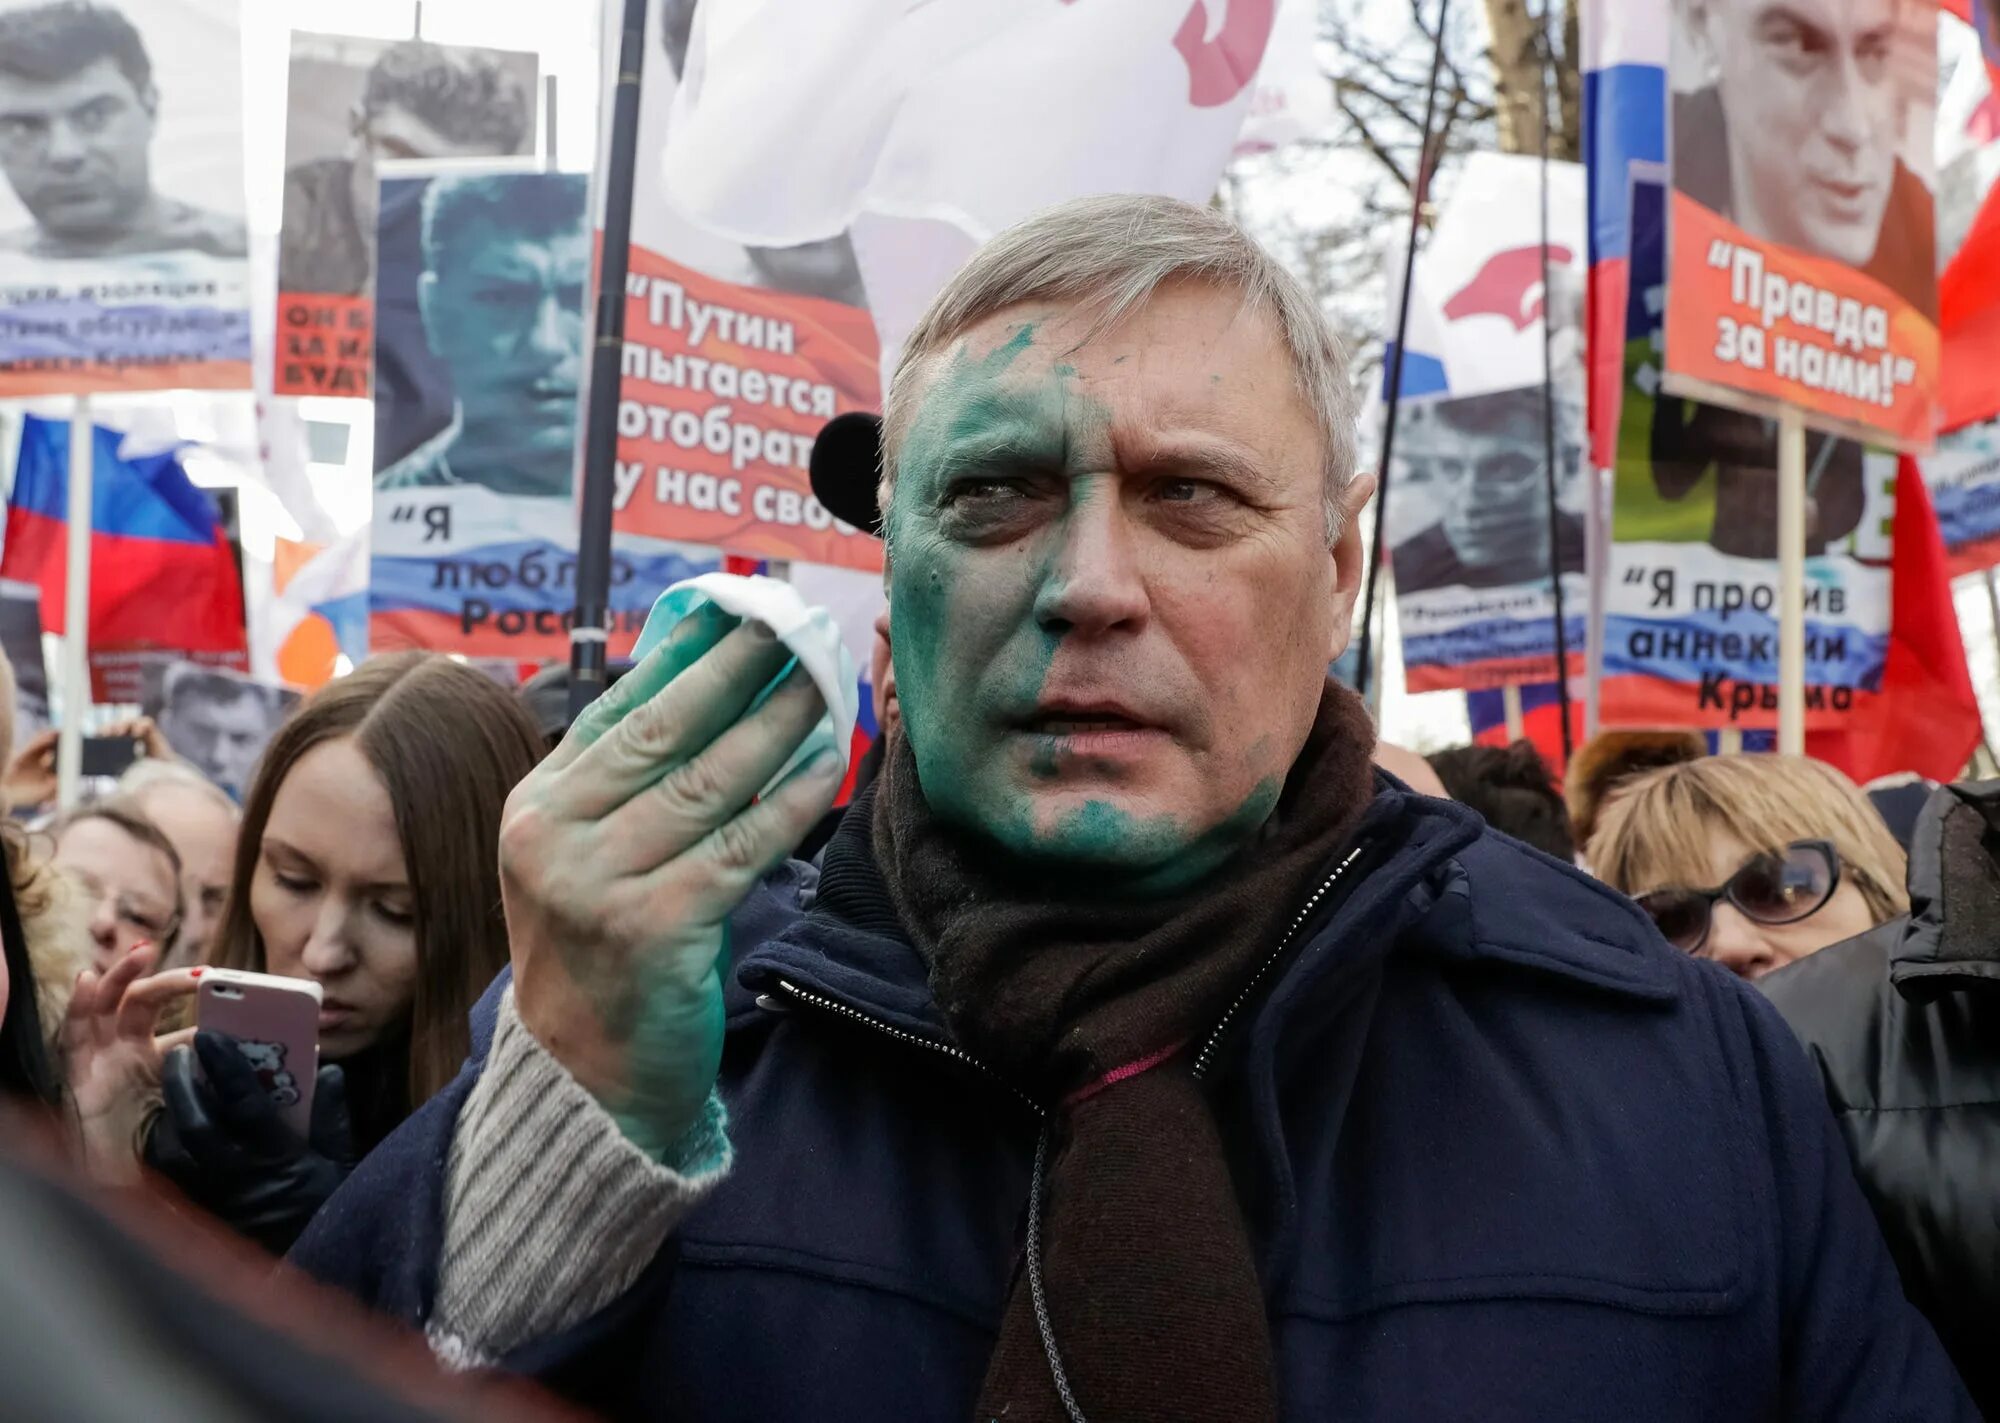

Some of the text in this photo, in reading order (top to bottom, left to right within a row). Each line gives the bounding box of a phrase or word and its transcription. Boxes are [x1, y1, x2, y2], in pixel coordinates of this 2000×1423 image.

[626, 272, 794, 354] “Путин
[1707, 240, 1887, 350] “Правда
[621, 342, 836, 418] пытается
[1714, 317, 1917, 407] за нами!”
[617, 400, 815, 470] отобрат
[611, 461, 644, 511] у
[656, 466, 742, 516] нас
[391, 505, 452, 544] “Я
[1623, 567, 1847, 620] “Я проив
[1628, 629, 1847, 661] аннекии
